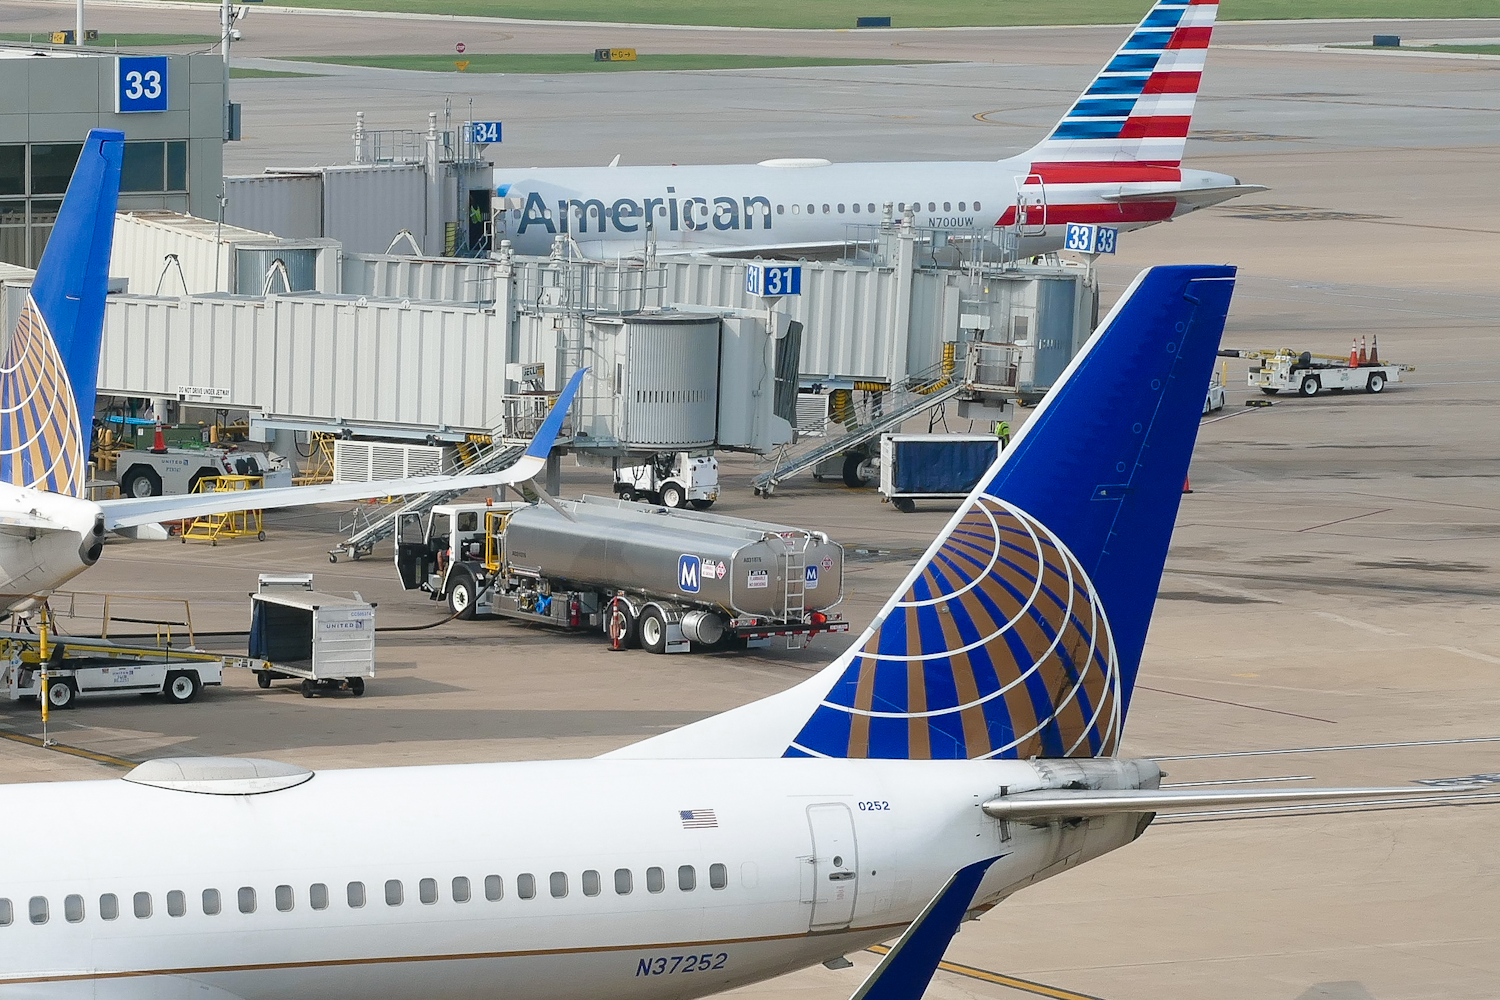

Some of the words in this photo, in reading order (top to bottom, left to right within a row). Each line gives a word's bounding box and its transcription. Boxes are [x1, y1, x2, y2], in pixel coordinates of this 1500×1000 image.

[125, 70, 162, 99] 33
[476, 123, 498, 141] 34
[516, 186, 772, 234] American
[928, 217, 974, 227] N700UW
[1069, 225, 1089, 250] 33
[1098, 228, 1114, 252] 33
[748, 266, 758, 293] 31
[768, 268, 792, 294] 31
[681, 561, 698, 588] M
[807, 568, 816, 579] M
[858, 801, 891, 811] 0252
[635, 952, 728, 977] N37252
